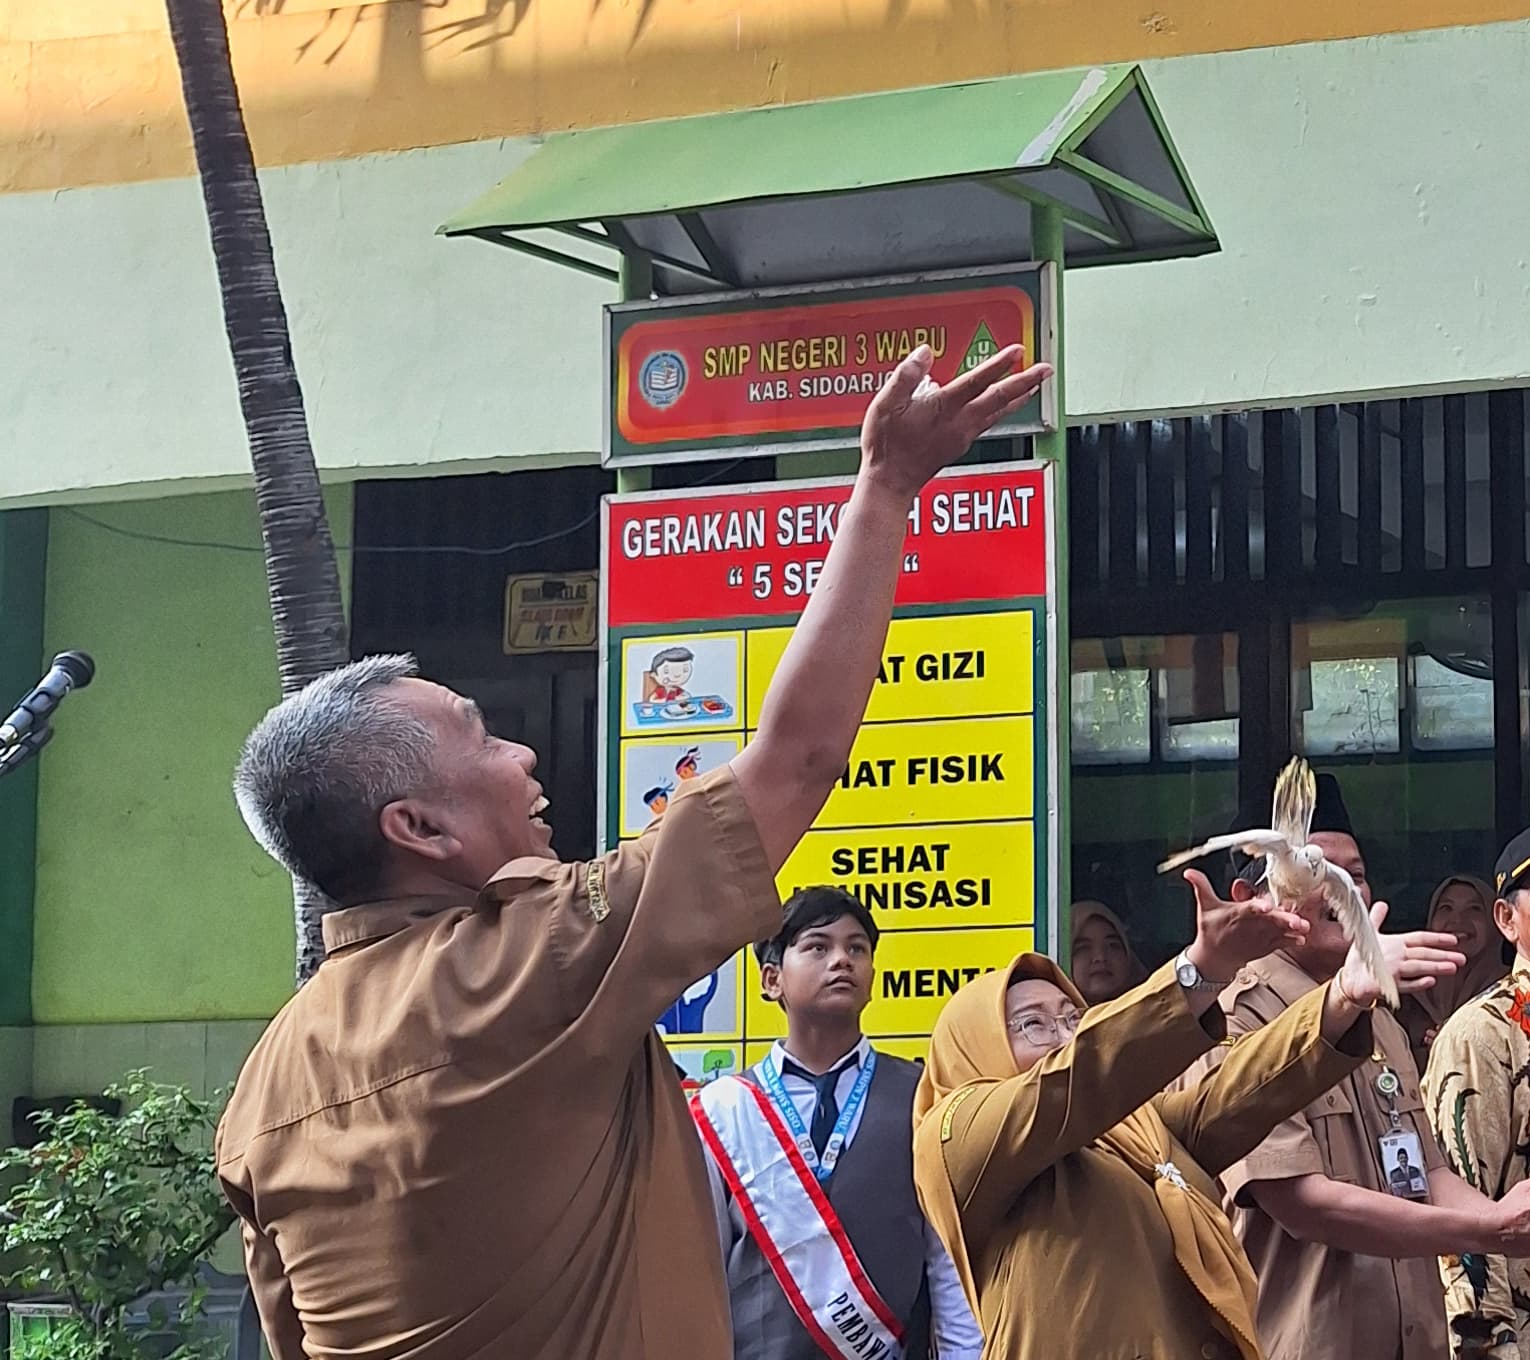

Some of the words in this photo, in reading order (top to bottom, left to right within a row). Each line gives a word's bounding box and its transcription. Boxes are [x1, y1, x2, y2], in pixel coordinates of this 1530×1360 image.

[703, 344, 752, 378] SMP
[760, 334, 846, 372] NEGERI
[855, 333, 867, 365] 3
[748, 380, 793, 402] KAB.
[623, 508, 765, 559] GERAKAN
[931, 486, 1035, 535] SEHAT
[753, 564, 772, 599] 5
[916, 650, 985, 682] GIZI
[907, 753, 1006, 786] FISIK
[831, 843, 951, 876] SEHAT
[883, 967, 996, 999] MENT
